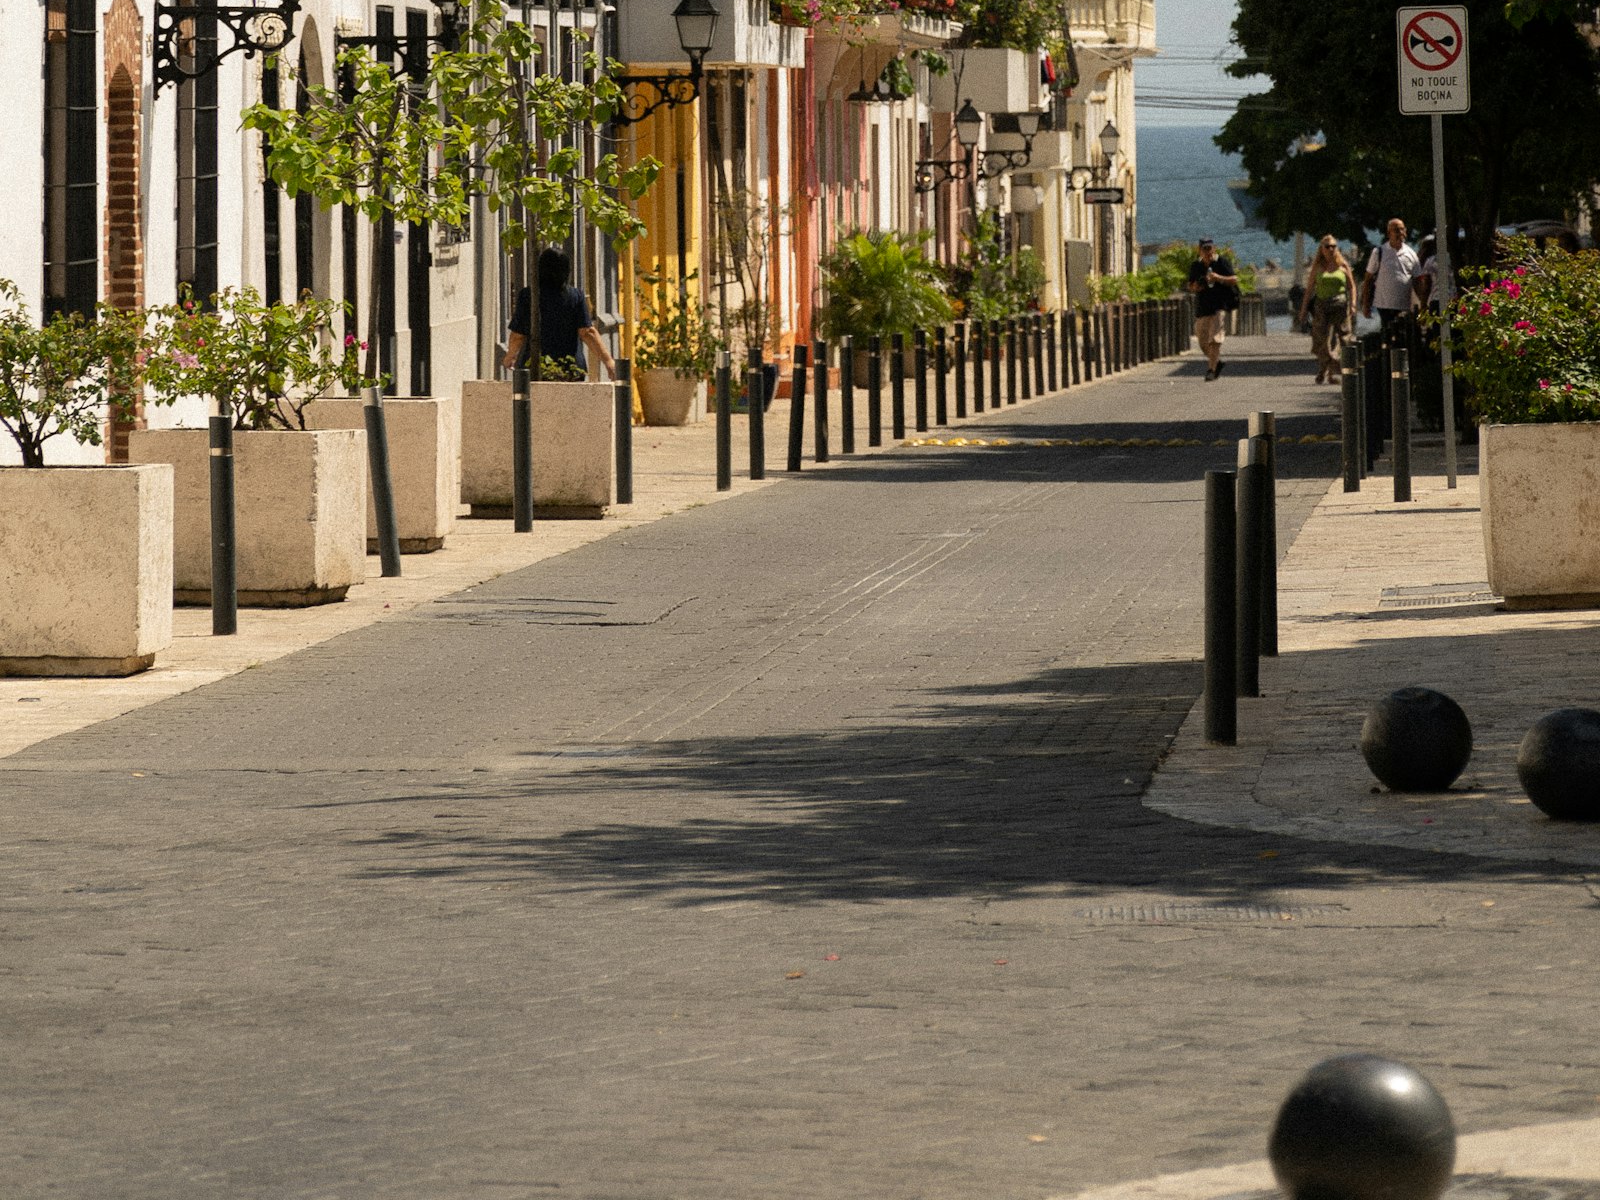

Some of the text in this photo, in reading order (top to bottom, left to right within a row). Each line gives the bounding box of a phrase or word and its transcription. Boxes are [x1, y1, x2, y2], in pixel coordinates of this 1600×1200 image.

[1411, 76, 1458, 87] NO TOQUE
[1417, 90, 1453, 100] BOCINA
